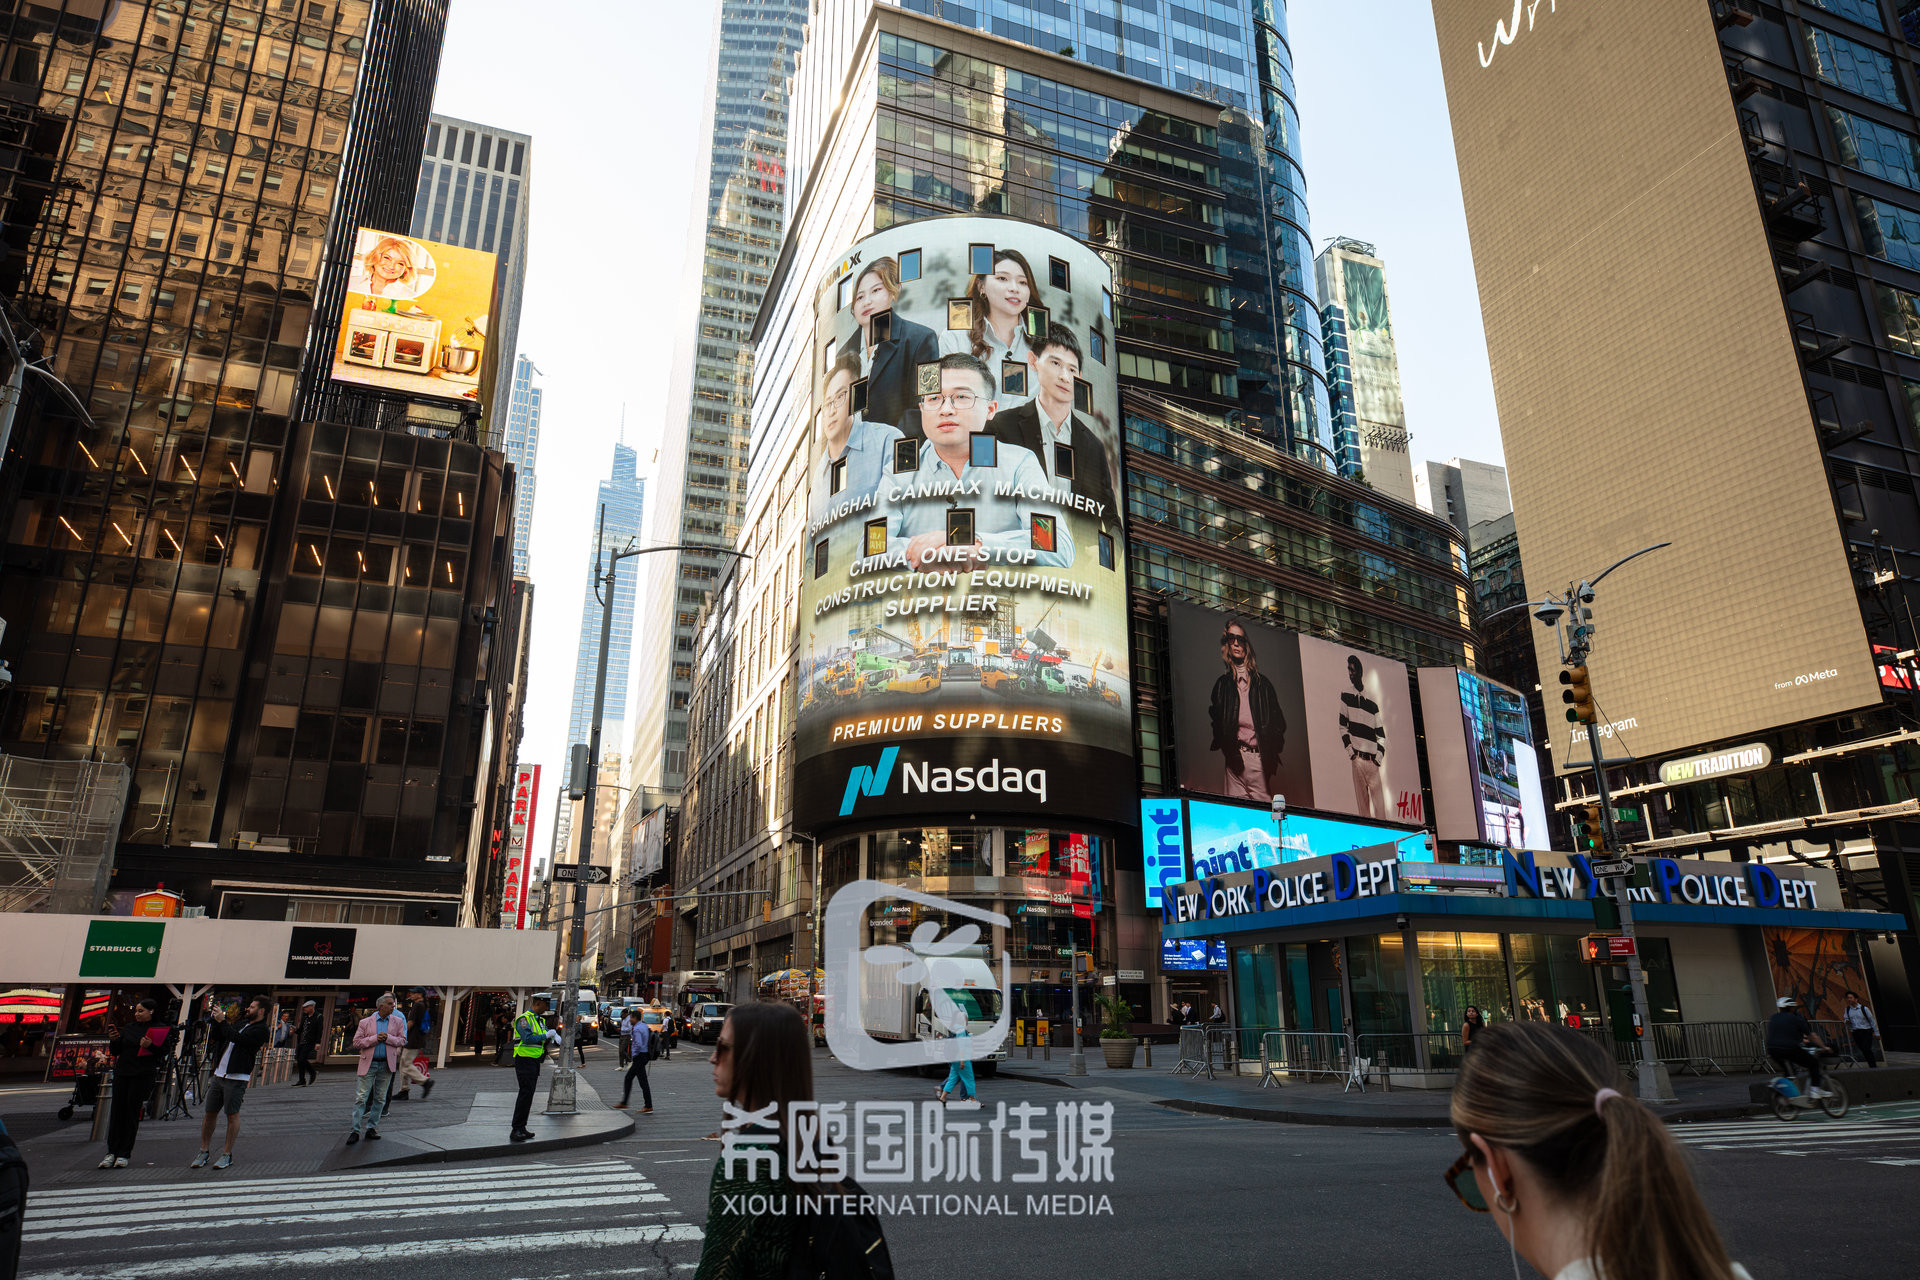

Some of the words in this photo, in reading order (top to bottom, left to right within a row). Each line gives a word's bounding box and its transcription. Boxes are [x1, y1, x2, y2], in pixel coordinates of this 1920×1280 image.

[811, 490, 879, 538] SHANGHAI
[888, 479, 983, 502] CANMAX
[994, 480, 1106, 517] MACHINERY
[850, 550, 908, 577] CHINA
[921, 546, 1037, 565] ONE-STOP
[815, 570, 957, 616] CONSTRUCTION
[970, 570, 1093, 600] EQUIPMENT
[885, 594, 998, 617] SUPPLIER
[1774, 680, 1793, 690] from
[1809, 668, 1838, 682] Meta
[832, 715, 923, 742] PREMIUM
[932, 713, 1063, 733] SUPPLIERS
[1570, 717, 1638, 744] Insagram
[902, 758, 1047, 803] Nasdaq
[513, 772, 531, 825] PARK
[1396, 790, 1422, 822] H&M
[561, 869, 577, 877] ONE
[1595, 865, 1609, 874] ONE
[1615, 863, 1628, 872] WAY
[1654, 857, 1750, 905] POLICE
[1750, 863, 1817, 909] DEPT
[503, 857, 521, 913] PARK
[1199, 877, 1250, 919] YORK
[1253, 868, 1325, 912] POLICE
[1331, 852, 1397, 900] DEPT
[1026, 906, 1047, 914] Nasdaq
[89, 945, 142, 953] STARBUCKS
